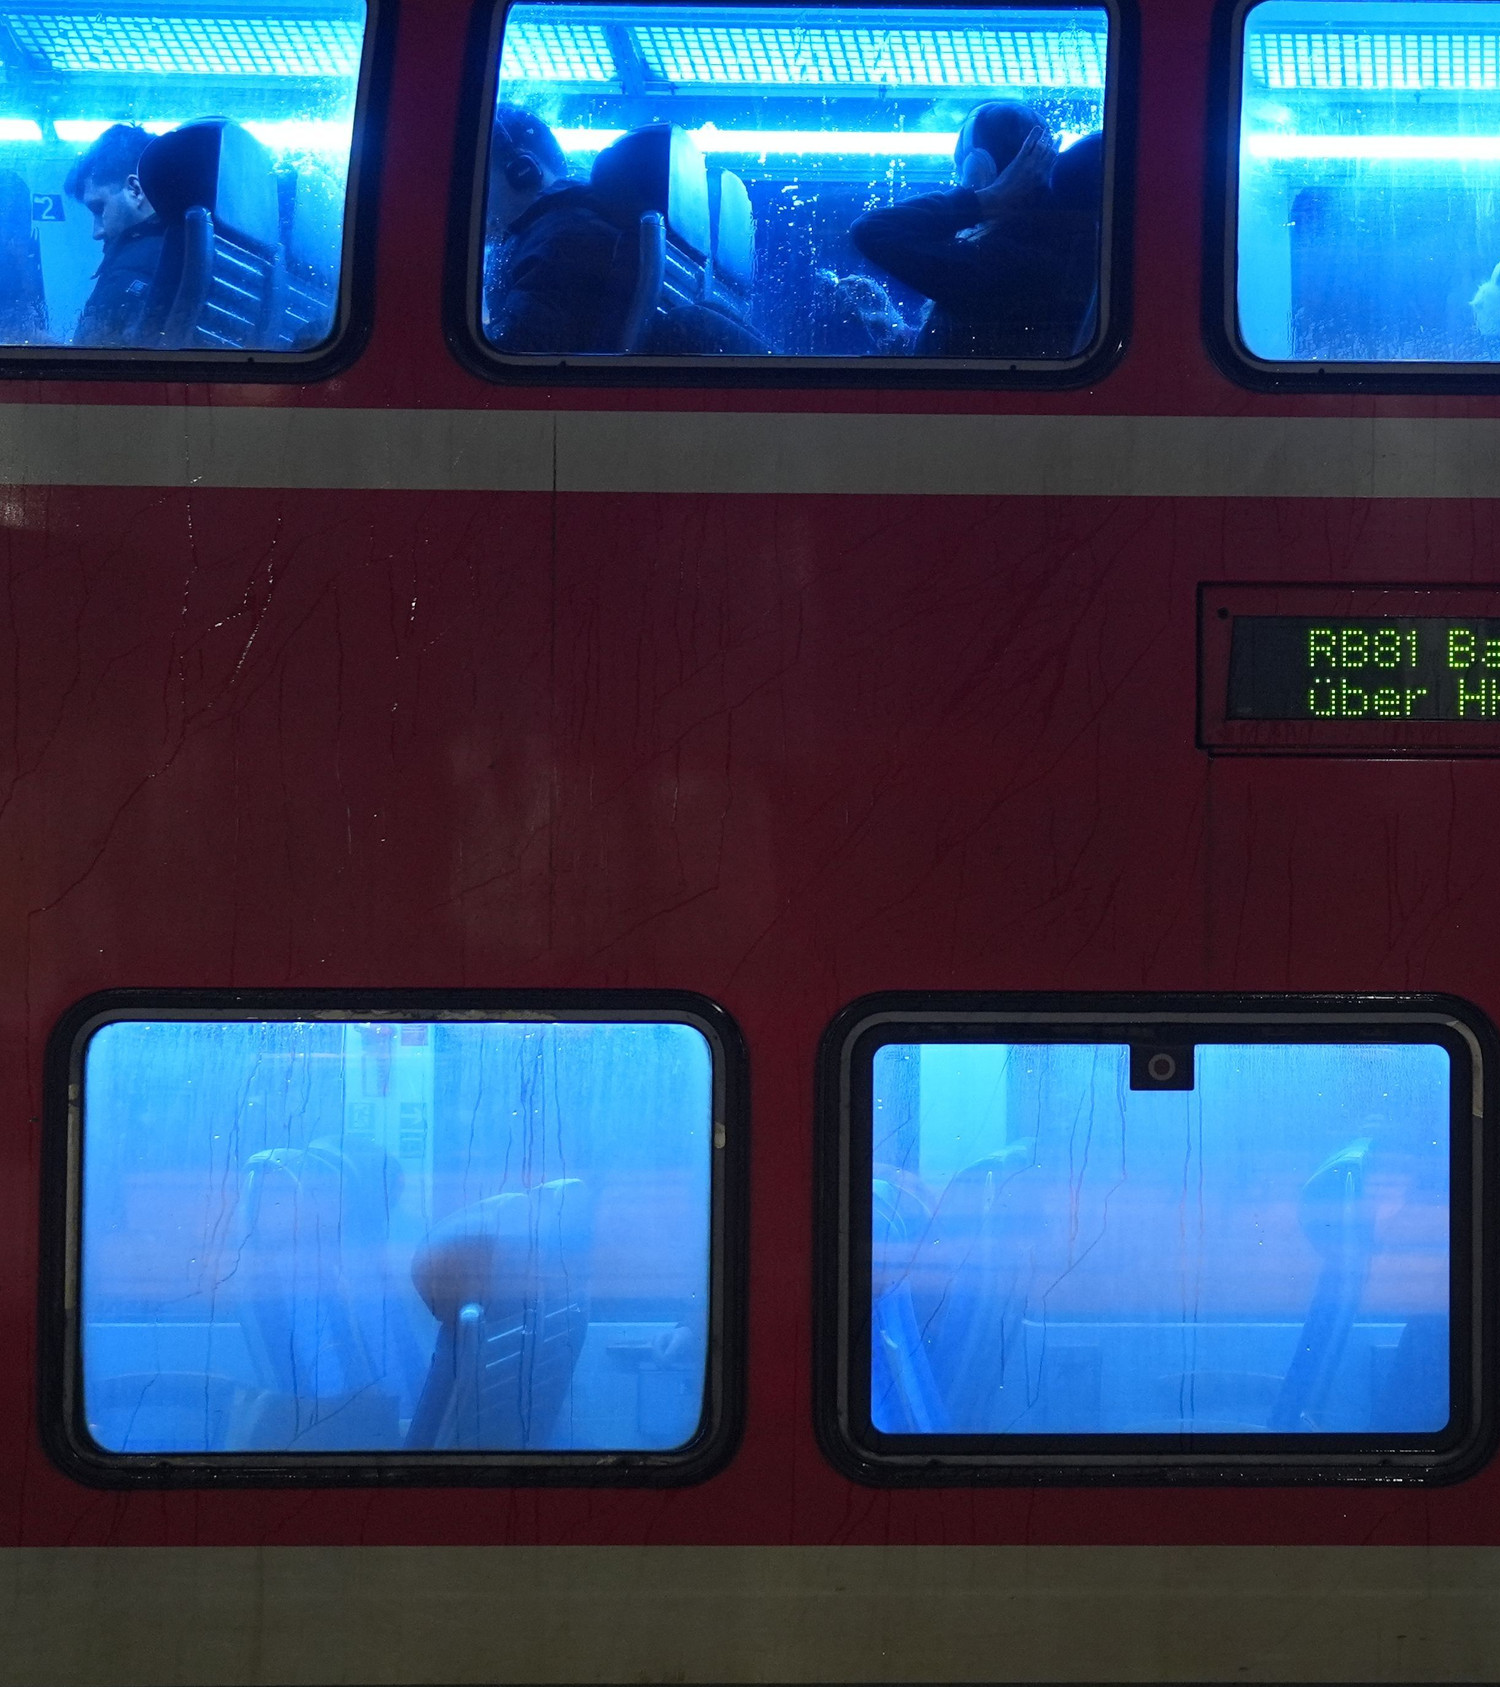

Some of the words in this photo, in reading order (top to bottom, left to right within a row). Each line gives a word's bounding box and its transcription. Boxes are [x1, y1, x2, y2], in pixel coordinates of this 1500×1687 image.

[34, 195, 57, 220] 2
[1308, 629, 1418, 669] RB81
[1308, 677, 1428, 717] über
